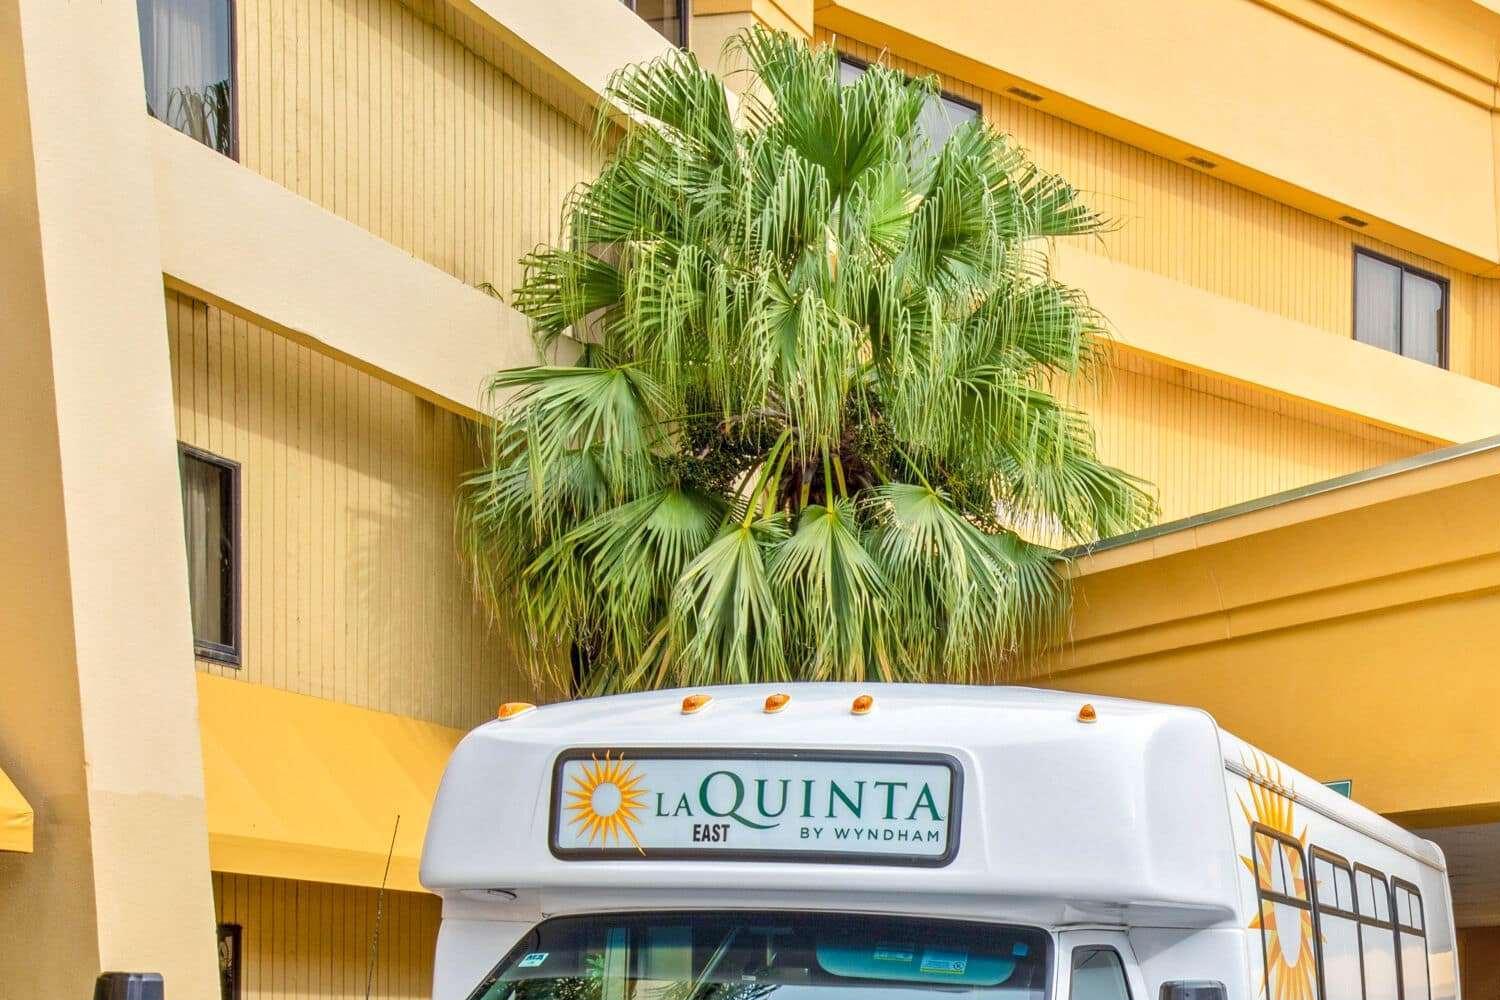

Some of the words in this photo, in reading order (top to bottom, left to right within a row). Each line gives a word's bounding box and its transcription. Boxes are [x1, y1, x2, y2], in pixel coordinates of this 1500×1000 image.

[655, 791, 694, 817] LA
[698, 770, 944, 830] QUINTA
[692, 823, 731, 843] EAST
[799, 827, 823, 840] BY
[834, 828, 941, 843] WYNDHAM
